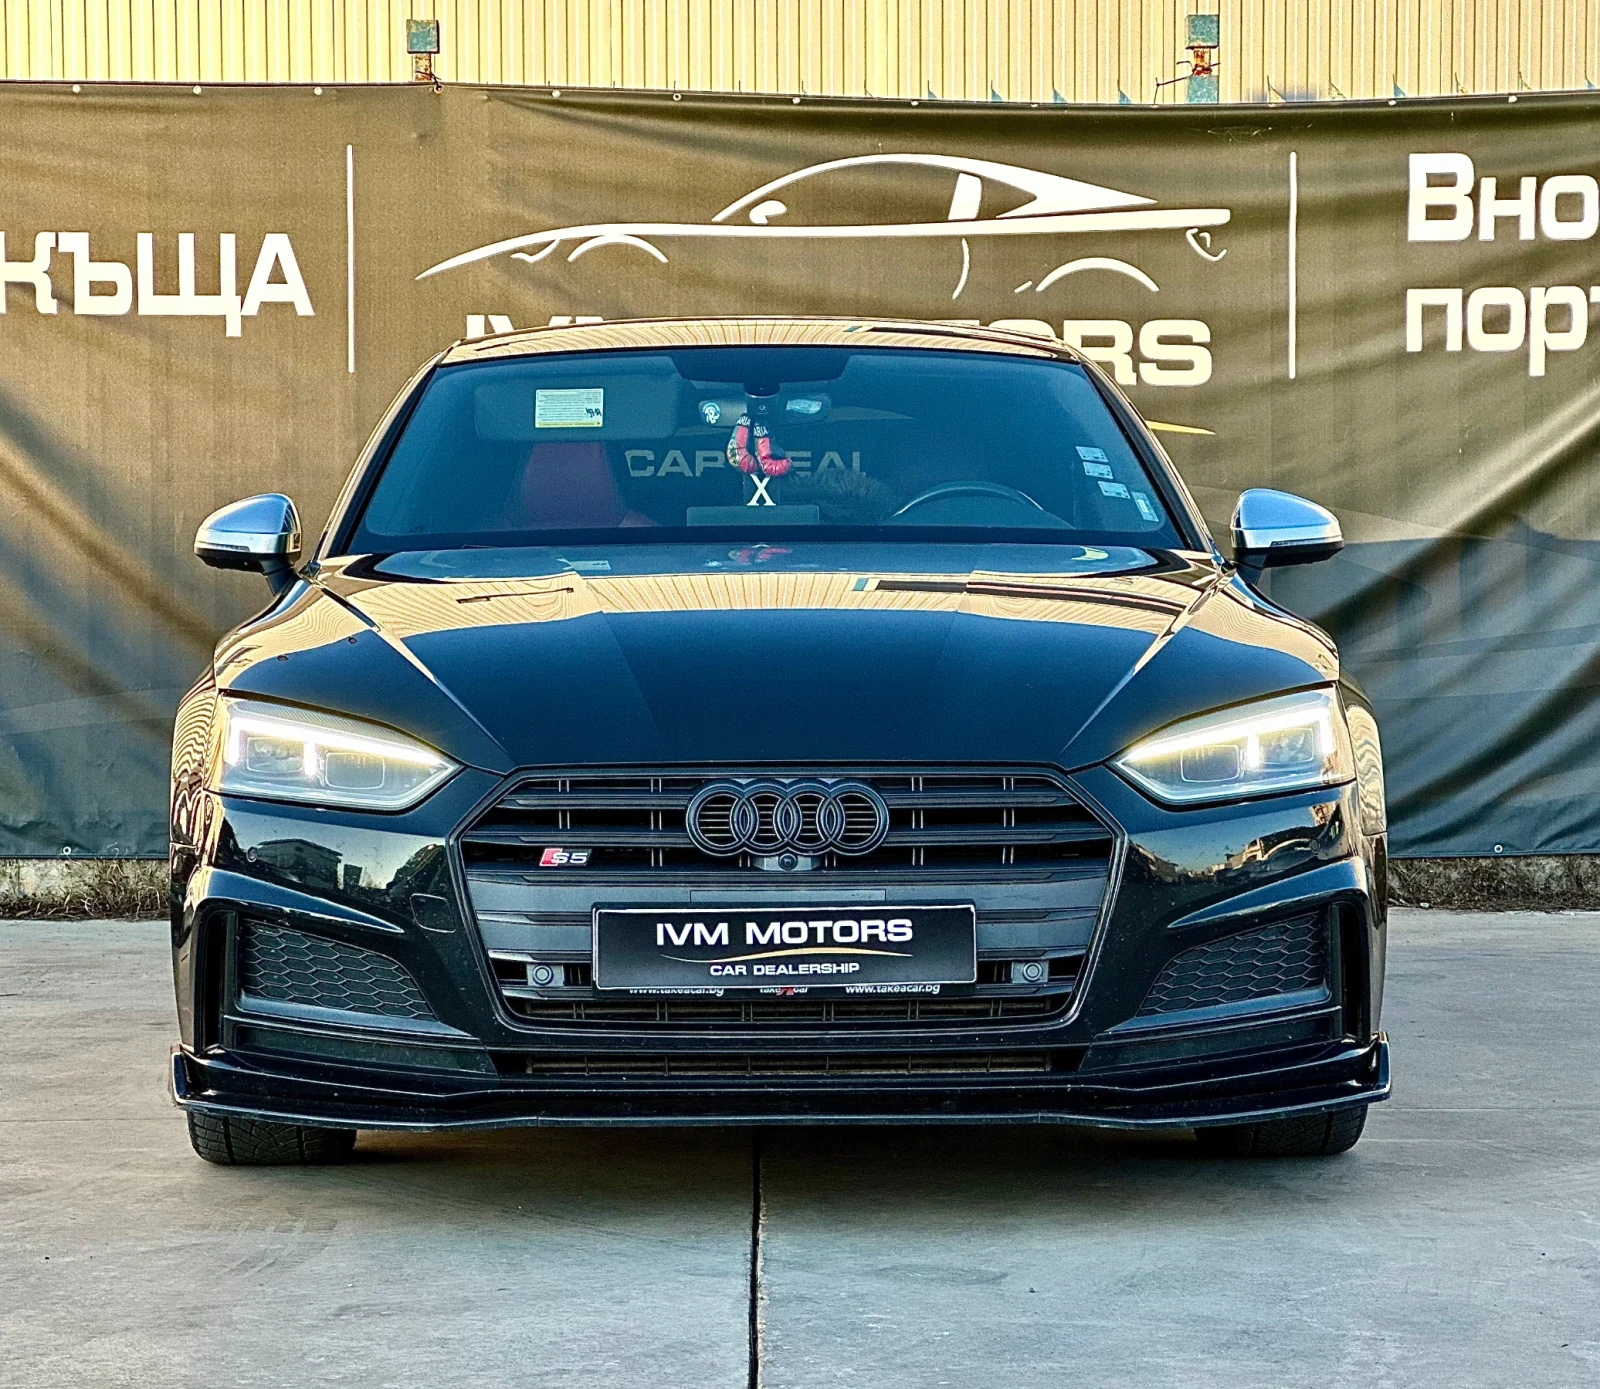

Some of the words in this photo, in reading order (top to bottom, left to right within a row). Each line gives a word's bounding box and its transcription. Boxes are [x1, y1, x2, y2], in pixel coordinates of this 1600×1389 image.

[1407, 152, 1600, 242] Вно
[0, 230, 316, 338] КЪЩА
[1405, 285, 1600, 377] пор
[549, 851, 590, 865] S5
[656, 921, 729, 946] IVM
[745, 918, 914, 945] MOTORS
[709, 964, 747, 976] CAR
[753, 963, 860, 976] DEALERSHIP
[845, 984, 941, 995] www.takeacar.bg
